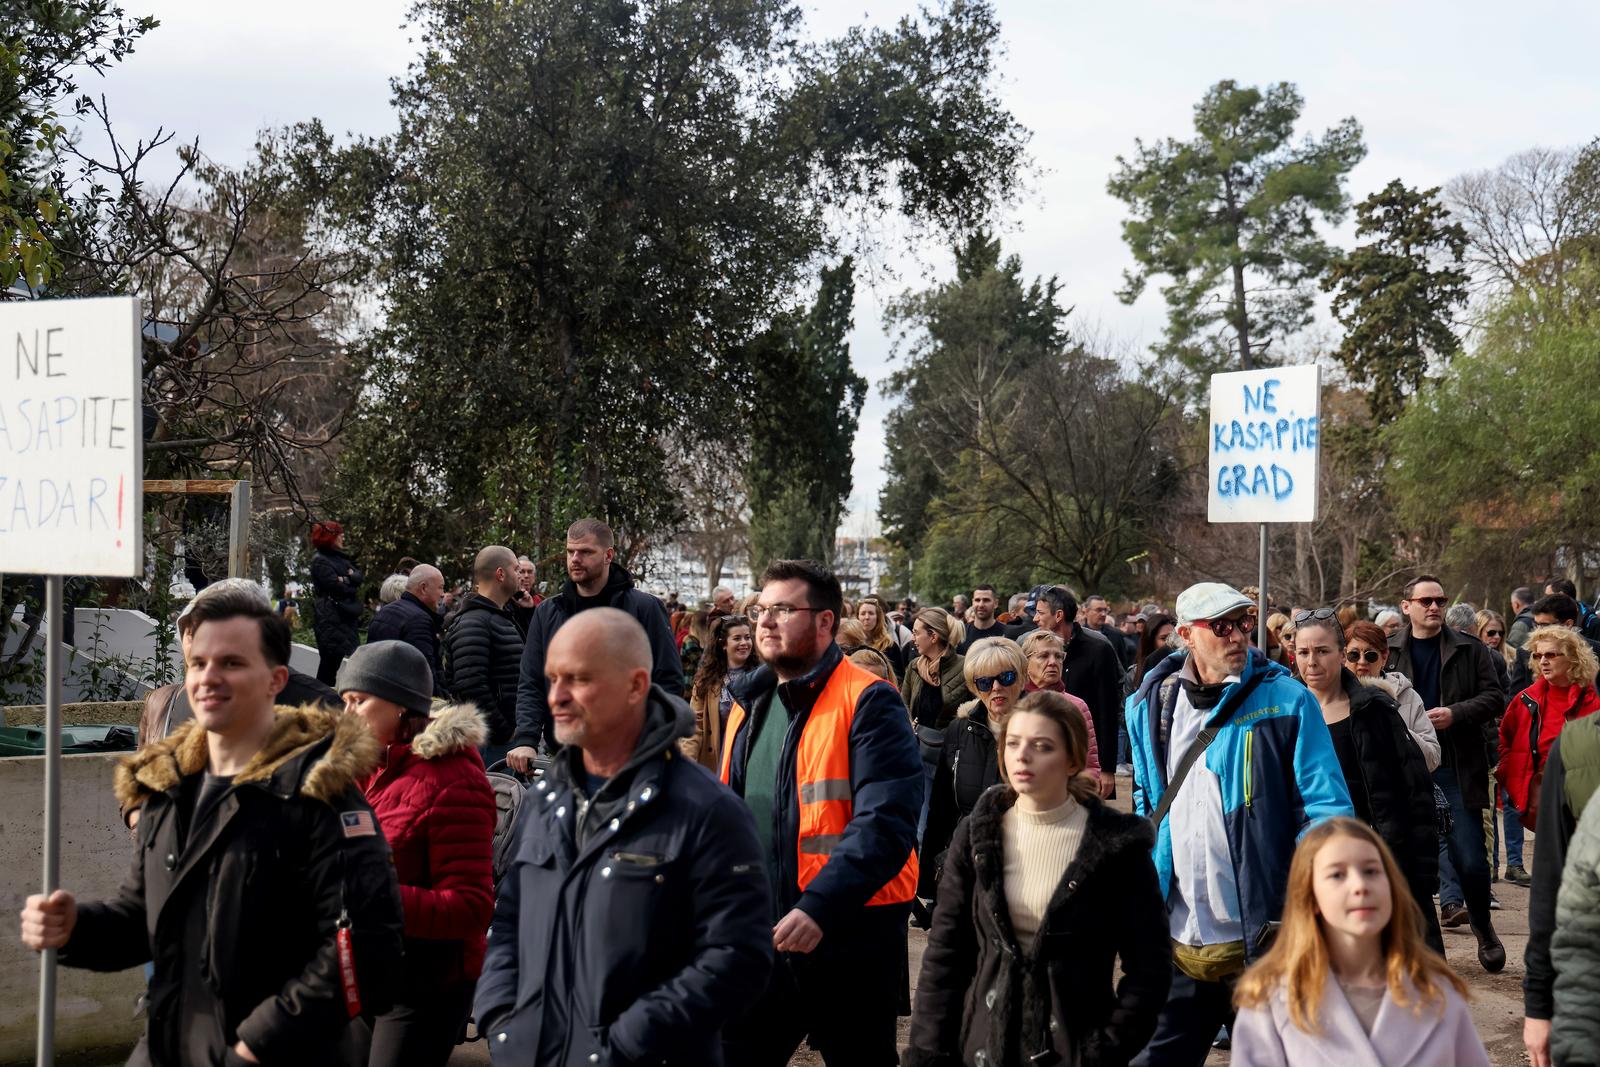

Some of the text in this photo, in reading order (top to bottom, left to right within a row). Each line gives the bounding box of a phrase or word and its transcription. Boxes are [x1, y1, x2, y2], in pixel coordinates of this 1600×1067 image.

[16, 327, 67, 380] NE
[1243, 379, 1281, 414] NE
[1214, 415, 1320, 453] KASAPITE
[1217, 463, 1294, 501] GRAD
